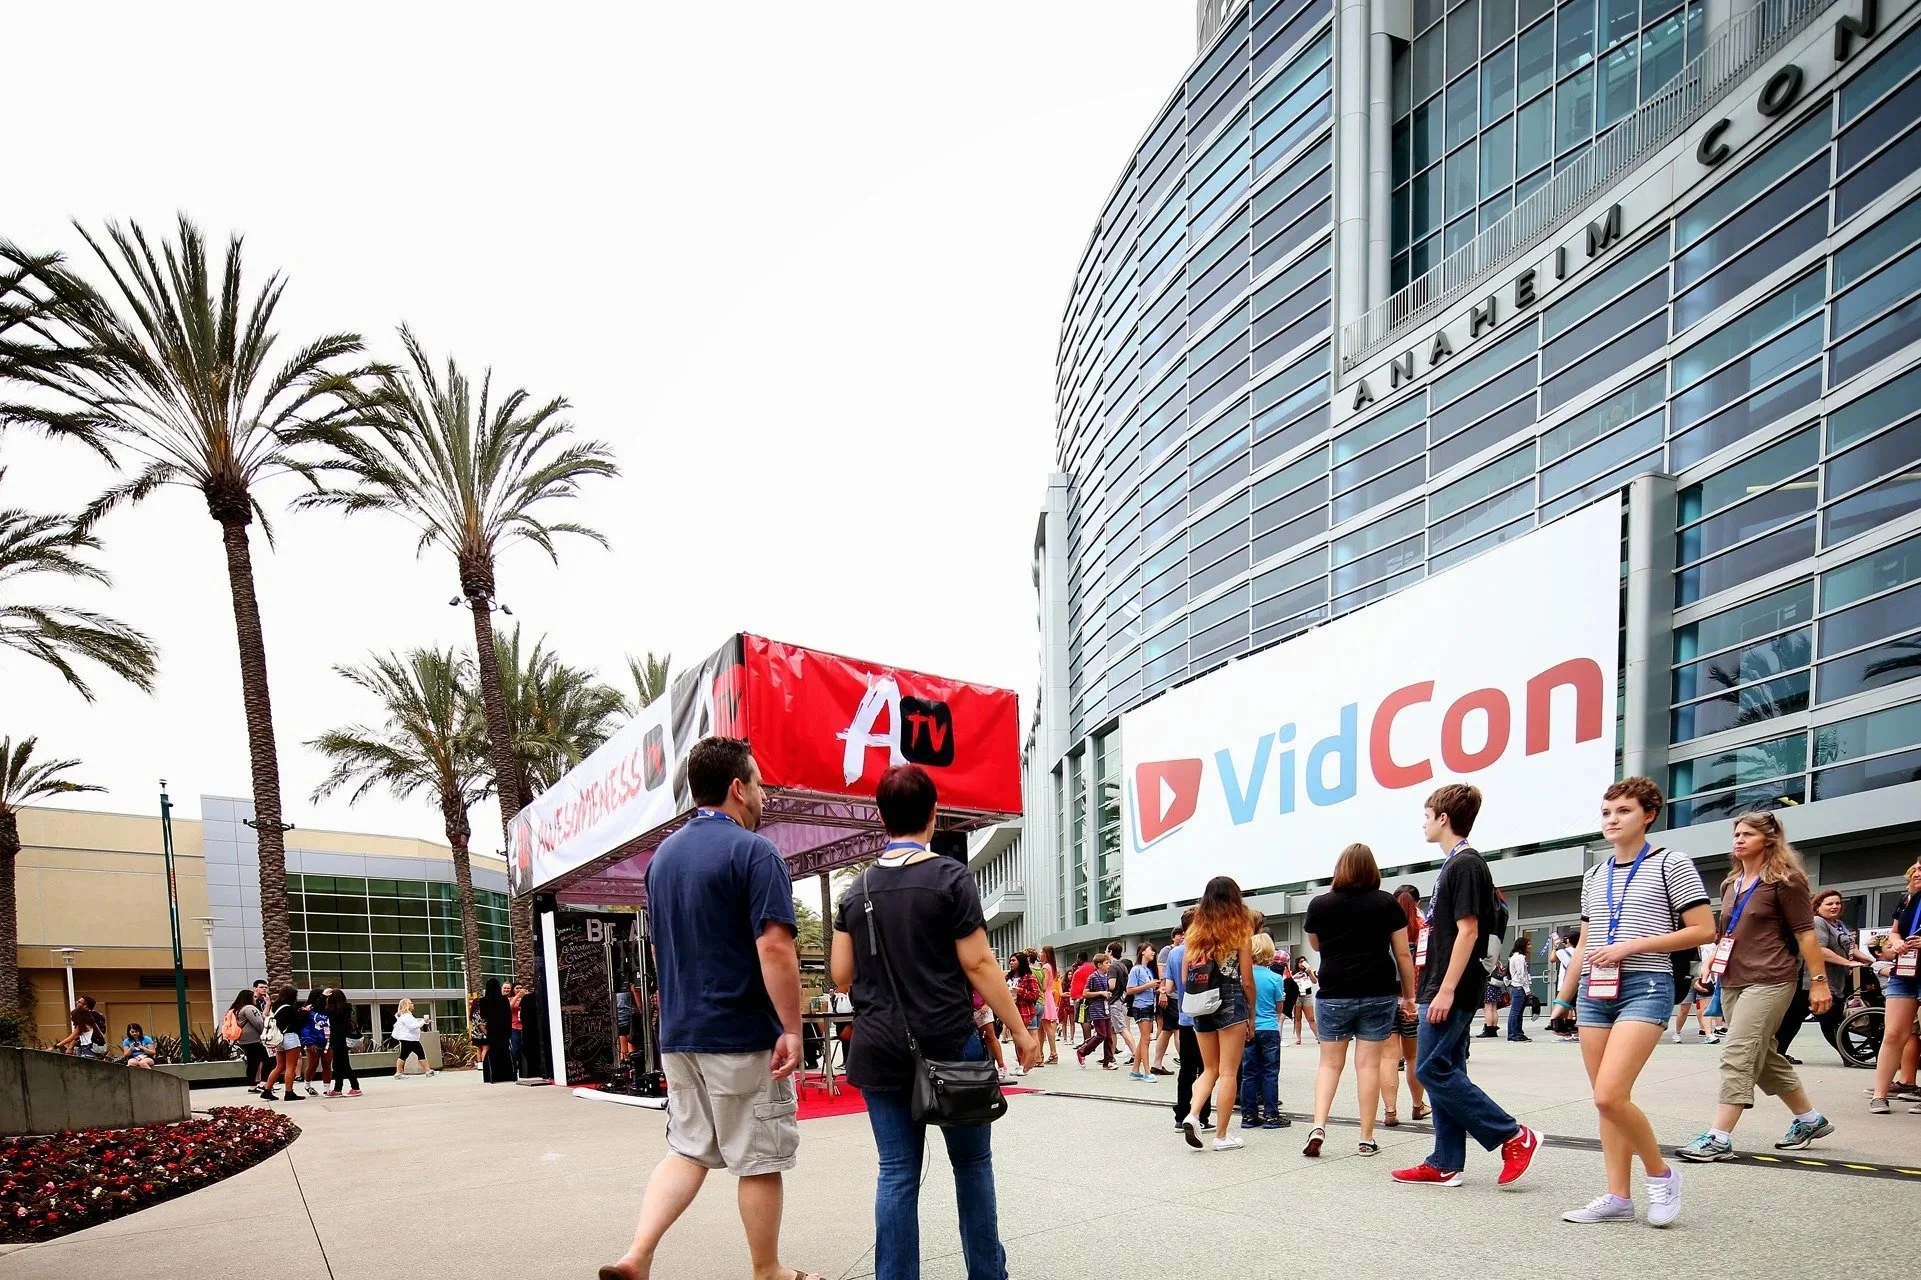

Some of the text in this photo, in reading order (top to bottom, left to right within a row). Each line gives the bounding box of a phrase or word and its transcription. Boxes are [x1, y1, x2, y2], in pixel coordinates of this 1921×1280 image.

[1352, 0, 1877, 411] ANAHEIM CON
[537, 748, 642, 860] AWESOMENESS
[1214, 656, 1604, 826] VidCon
[1187, 973, 1209, 982] idCon
